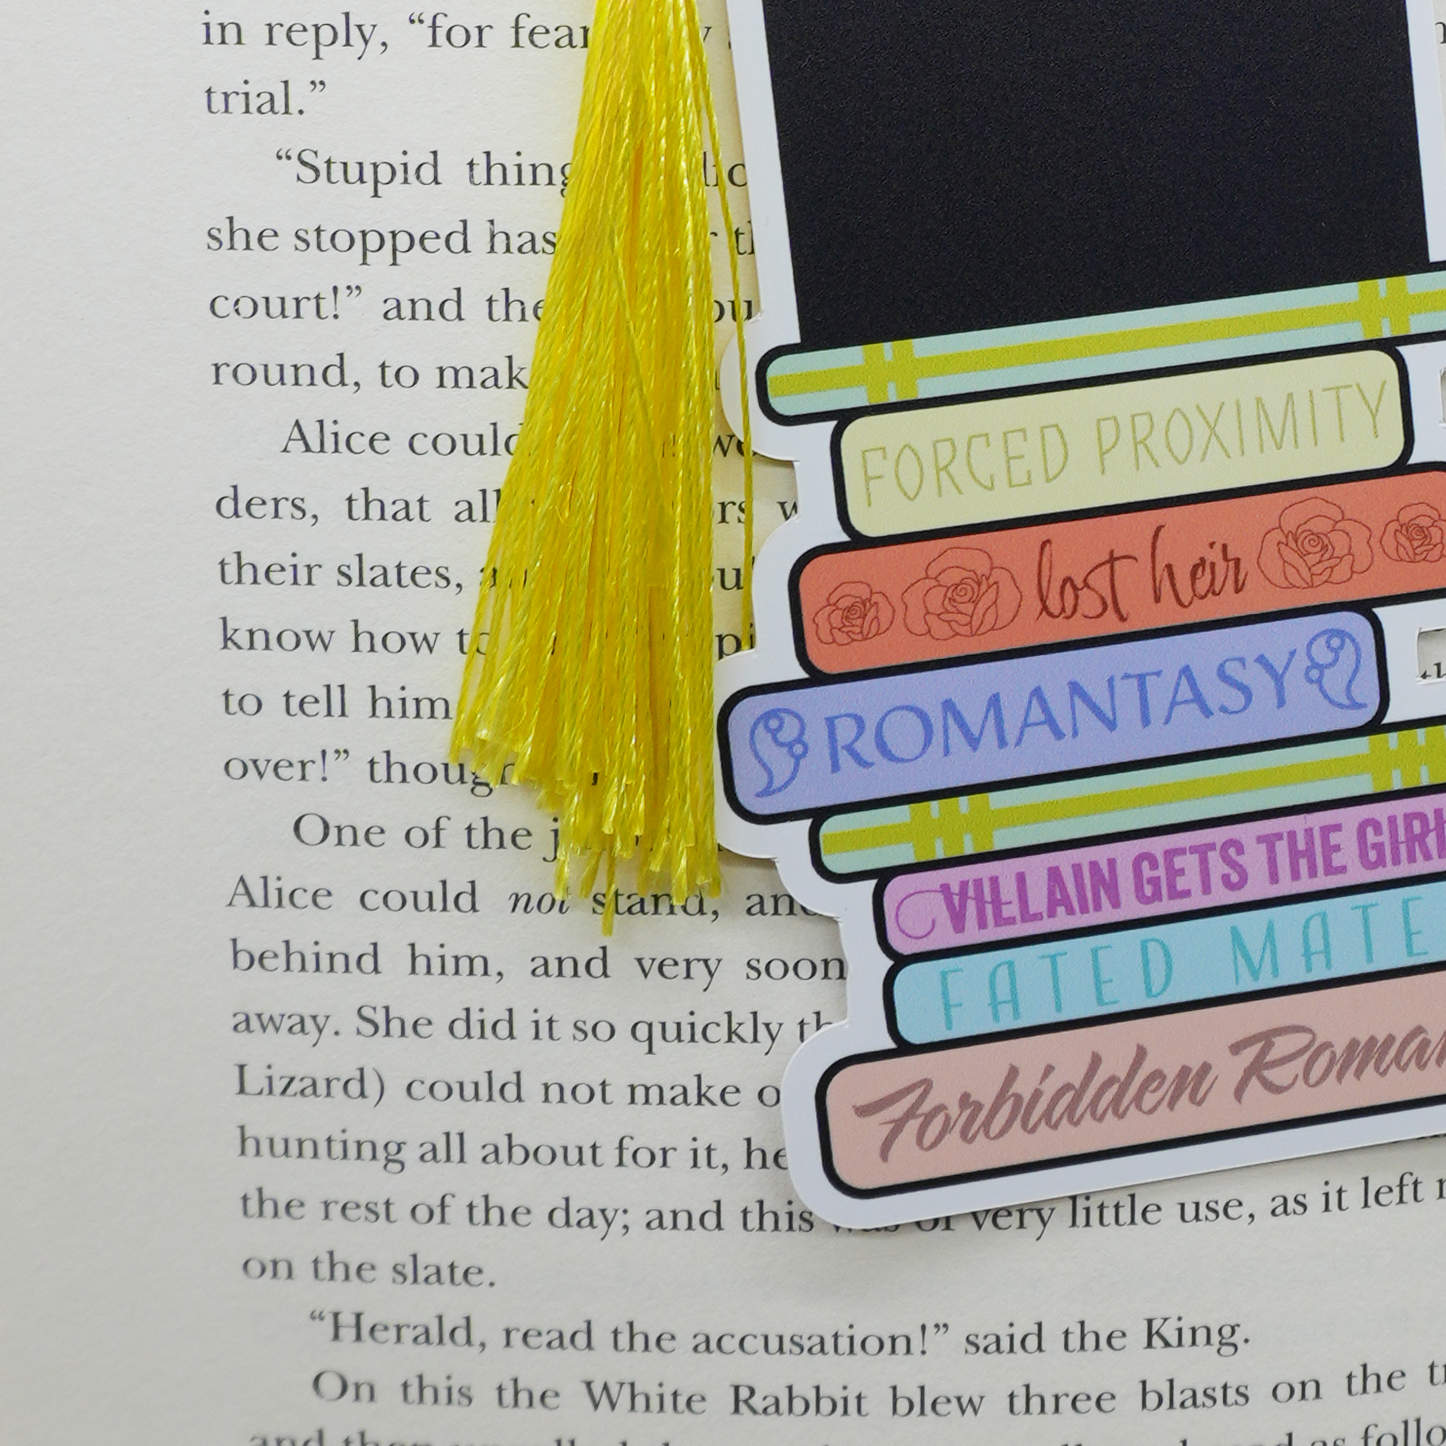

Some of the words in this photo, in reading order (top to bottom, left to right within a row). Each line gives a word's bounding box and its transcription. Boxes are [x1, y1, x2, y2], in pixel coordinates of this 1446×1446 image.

[202, 10, 245, 45] in
[265, 12, 388, 60] reply,
[409, 12, 493, 48] “for
[205, 79, 326, 115] trial.”
[207, 216, 279, 251] she
[294, 219, 472, 266] stopped
[280, 419, 390, 455] Alice
[861, 423, 1070, 508] FORCED
[1098, 380, 1388, 475] PROXIMITY
[218, 551, 322, 586] their
[337, 553, 462, 595] slates,
[1035, 539, 1138, 622] lost
[1152, 525, 1249, 610] heir
[824, 648, 1296, 774] ROMANTASY
[293, 813, 385, 847] One
[405, 816, 451, 848] of
[465, 816, 532, 850] the
[938, 861, 1120, 935] VILLAIN
[1133, 838, 1249, 906] GETS
[1256, 821, 1349, 884] THE
[230, 938, 382, 975] behind
[407, 943, 503, 983] him,
[531, 945, 611, 979] and
[634, 957, 722, 992] very
[746, 948, 847, 981] soon
[939, 937, 1174, 1031] FATED
[851, 1044, 1219, 1164] Forbidden
[241, 1187, 305, 1219] the
[322, 1198, 397, 1223] rest
[410, 1193, 455, 1224] of
[467, 1194, 531, 1227] the
[548, 1196, 629, 1241] day;
[646, 1199, 724, 1231] and
[741, 1199, 814, 1232] this
[1068, 1194, 1164, 1230] little
[1176, 1198, 1257, 1227] use,
[1271, 1193, 1309, 1218] as
[1321, 1179, 1351, 1214] it
[1360, 1171, 1426, 1211] left
[310, 1310, 486, 1353] “Herald,
[504, 1320, 594, 1351] read
[611, 1320, 676, 1353] the
[692, 1323, 949, 1356] accusation!”
[965, 1321, 1045, 1355] said
[1062, 1320, 1127, 1353] the
[1144, 1316, 1249, 1357] King.
